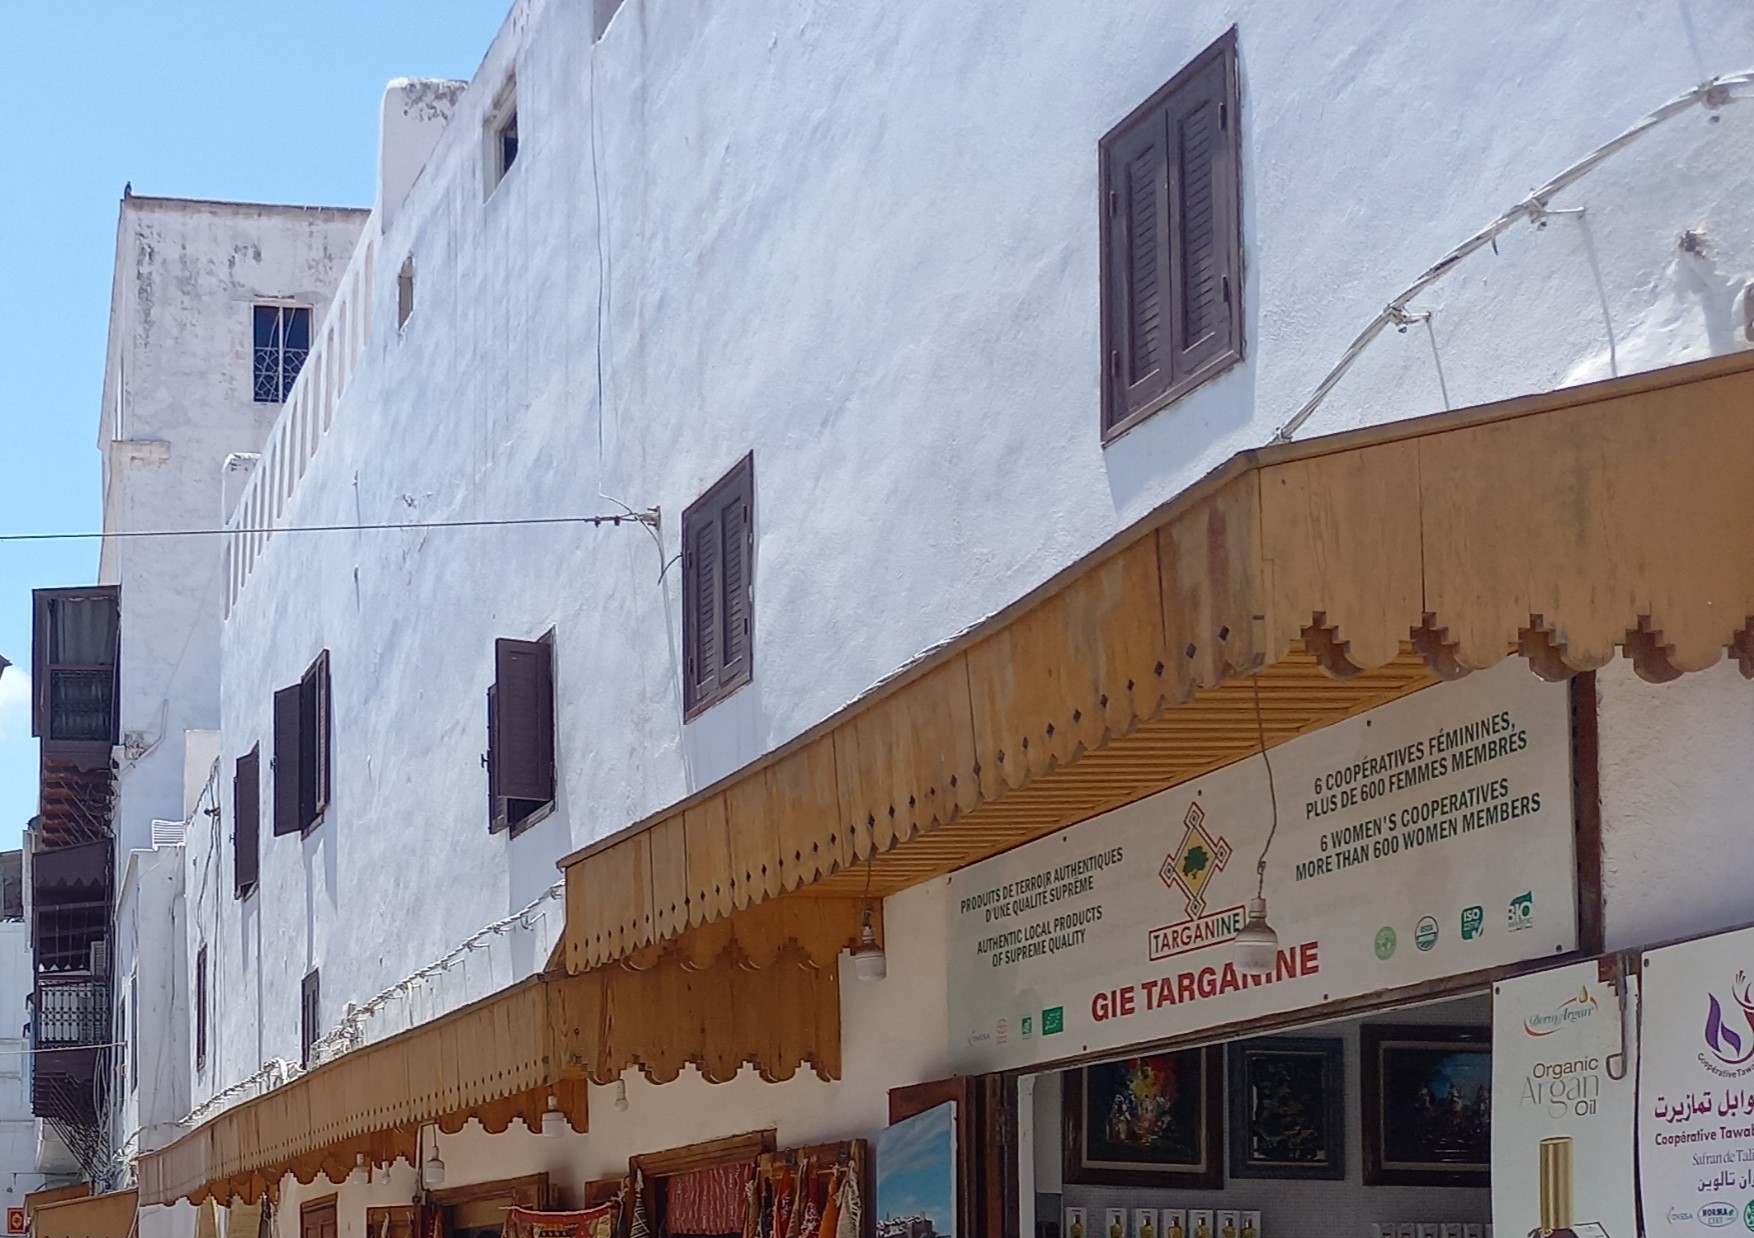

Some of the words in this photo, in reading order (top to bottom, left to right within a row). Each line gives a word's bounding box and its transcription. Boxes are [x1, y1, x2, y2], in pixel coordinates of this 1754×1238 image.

[1314, 777, 1322, 795] 6
[1325, 741, 1424, 791] COOPÉRATIVES
[1429, 711, 1516, 756] FÉMININES,
[1306, 794, 1338, 820] PLUS
[1341, 787, 1358, 809] DE
[1360, 778, 1386, 802] 600
[1389, 757, 1448, 793] FEMMES
[1451, 730, 1527, 772] MEMBRES
[1320, 835, 1328, 852] 6
[1331, 812, 1397, 849] WOMEN'S
[1401, 778, 1509, 827] COOPERATIVES
[1296, 857, 1333, 882] MORE
[1335, 843, 1370, 871] THAN
[1374, 836, 1399, 859] 600
[1402, 817, 1458, 850] WOMEN
[1462, 792, 1541, 833] MEMBERS
[961, 888, 1001, 914] PRODUITS
[1003, 883, 1015, 901] DE
[1016, 871, 1053, 897] TERROIR
[1053, 847, 1124, 884] AUTHENTIQUES
[977, 929, 1023, 955] AUTHENTIC
[1024, 920, 1052, 942] LOCAL
[1054, 905, 1103, 933] PRODUCTS
[985, 900, 1011, 923] D'UNE
[1463, 908, 1480, 922] ISO
[1508, 902, 1532, 922] BIO
[992, 952, 1003, 968] OF
[1005, 939, 1047, 965] SUPREME
[1048, 928, 1087, 955] QUALITY
[1153, 912, 1242, 954] TARGANINE
[1091, 985, 1135, 1022] GIE
[1533, 1056, 1599, 1079] Organic
[1519, 1074, 1599, 1119] Argan
[1574, 1099, 1597, 1116] Oil
[1655, 1129, 1717, 1147] Coopérative
